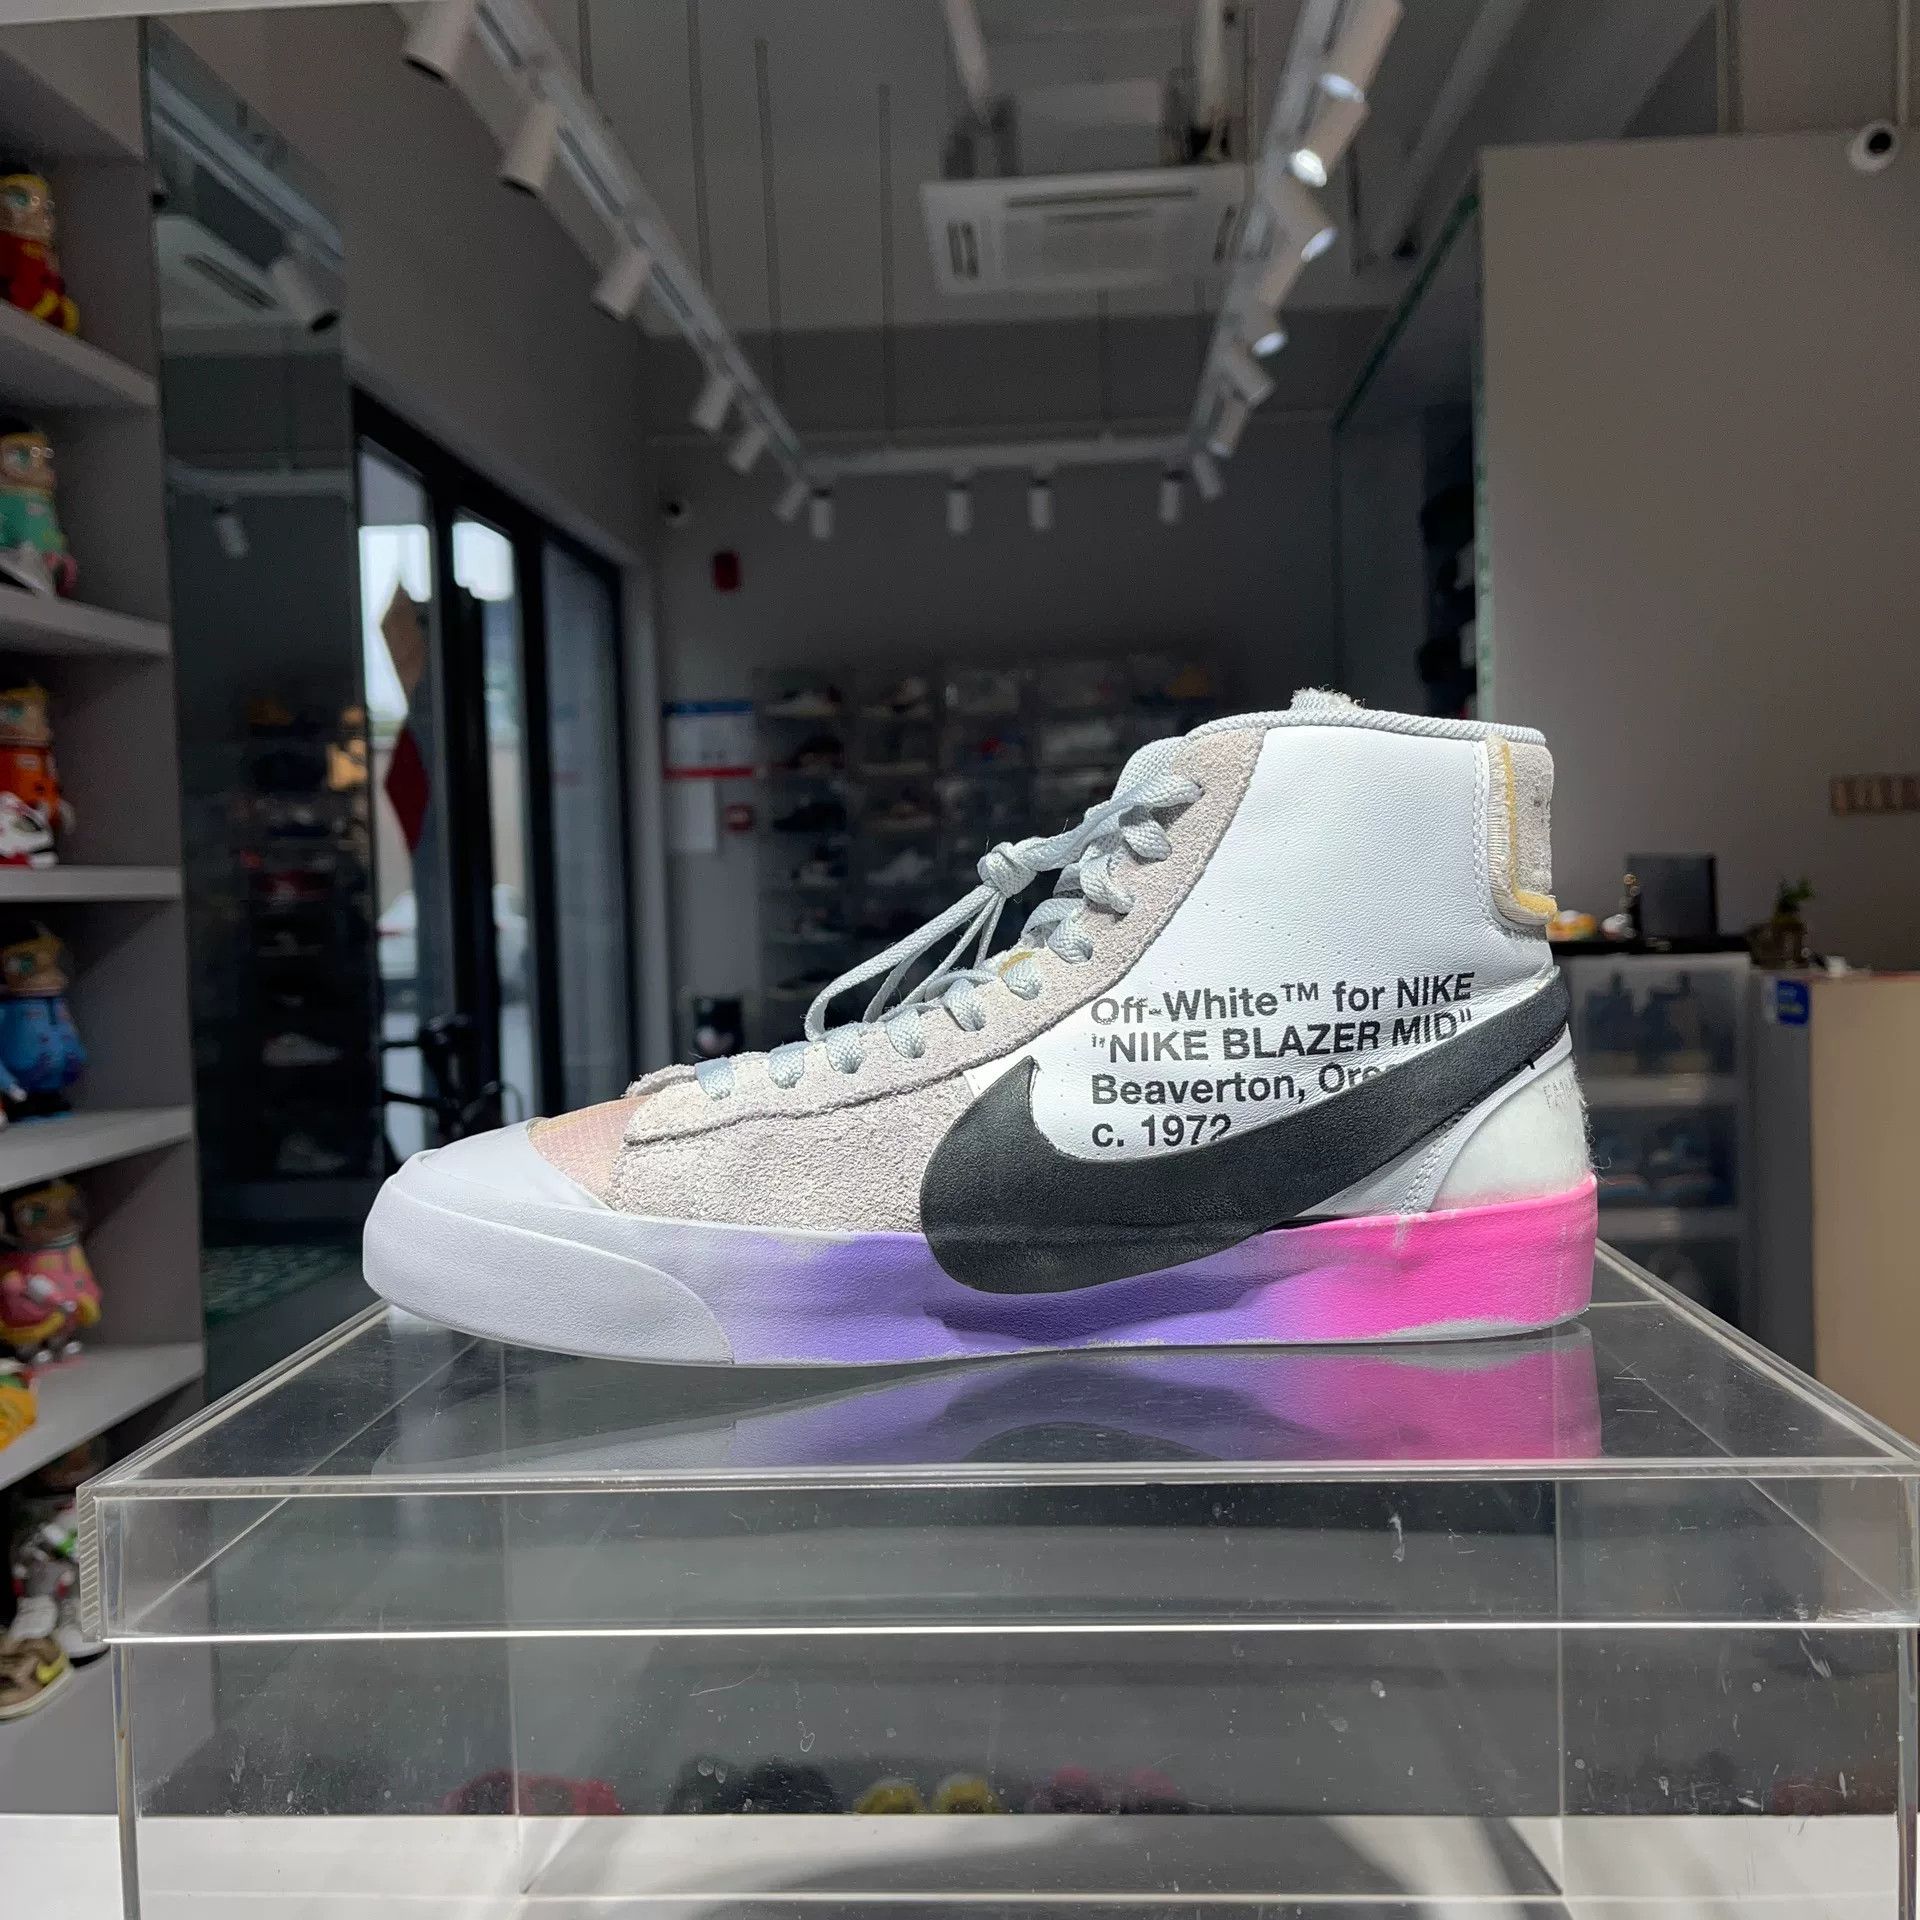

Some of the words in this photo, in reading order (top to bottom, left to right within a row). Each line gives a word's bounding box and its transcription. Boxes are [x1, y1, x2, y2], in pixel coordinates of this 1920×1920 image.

[1332, 982, 1385, 1012] for
[1396, 972, 1476, 1008] NIKE
[1223, 1021, 1381, 1061] BLAZER
[1391, 1008, 1472, 1047] MID"
[1091, 1072, 1306, 1105] Beaverton,
[1091, 1122, 1125, 1148] c.
[1140, 1112, 1232, 1148] 1972
